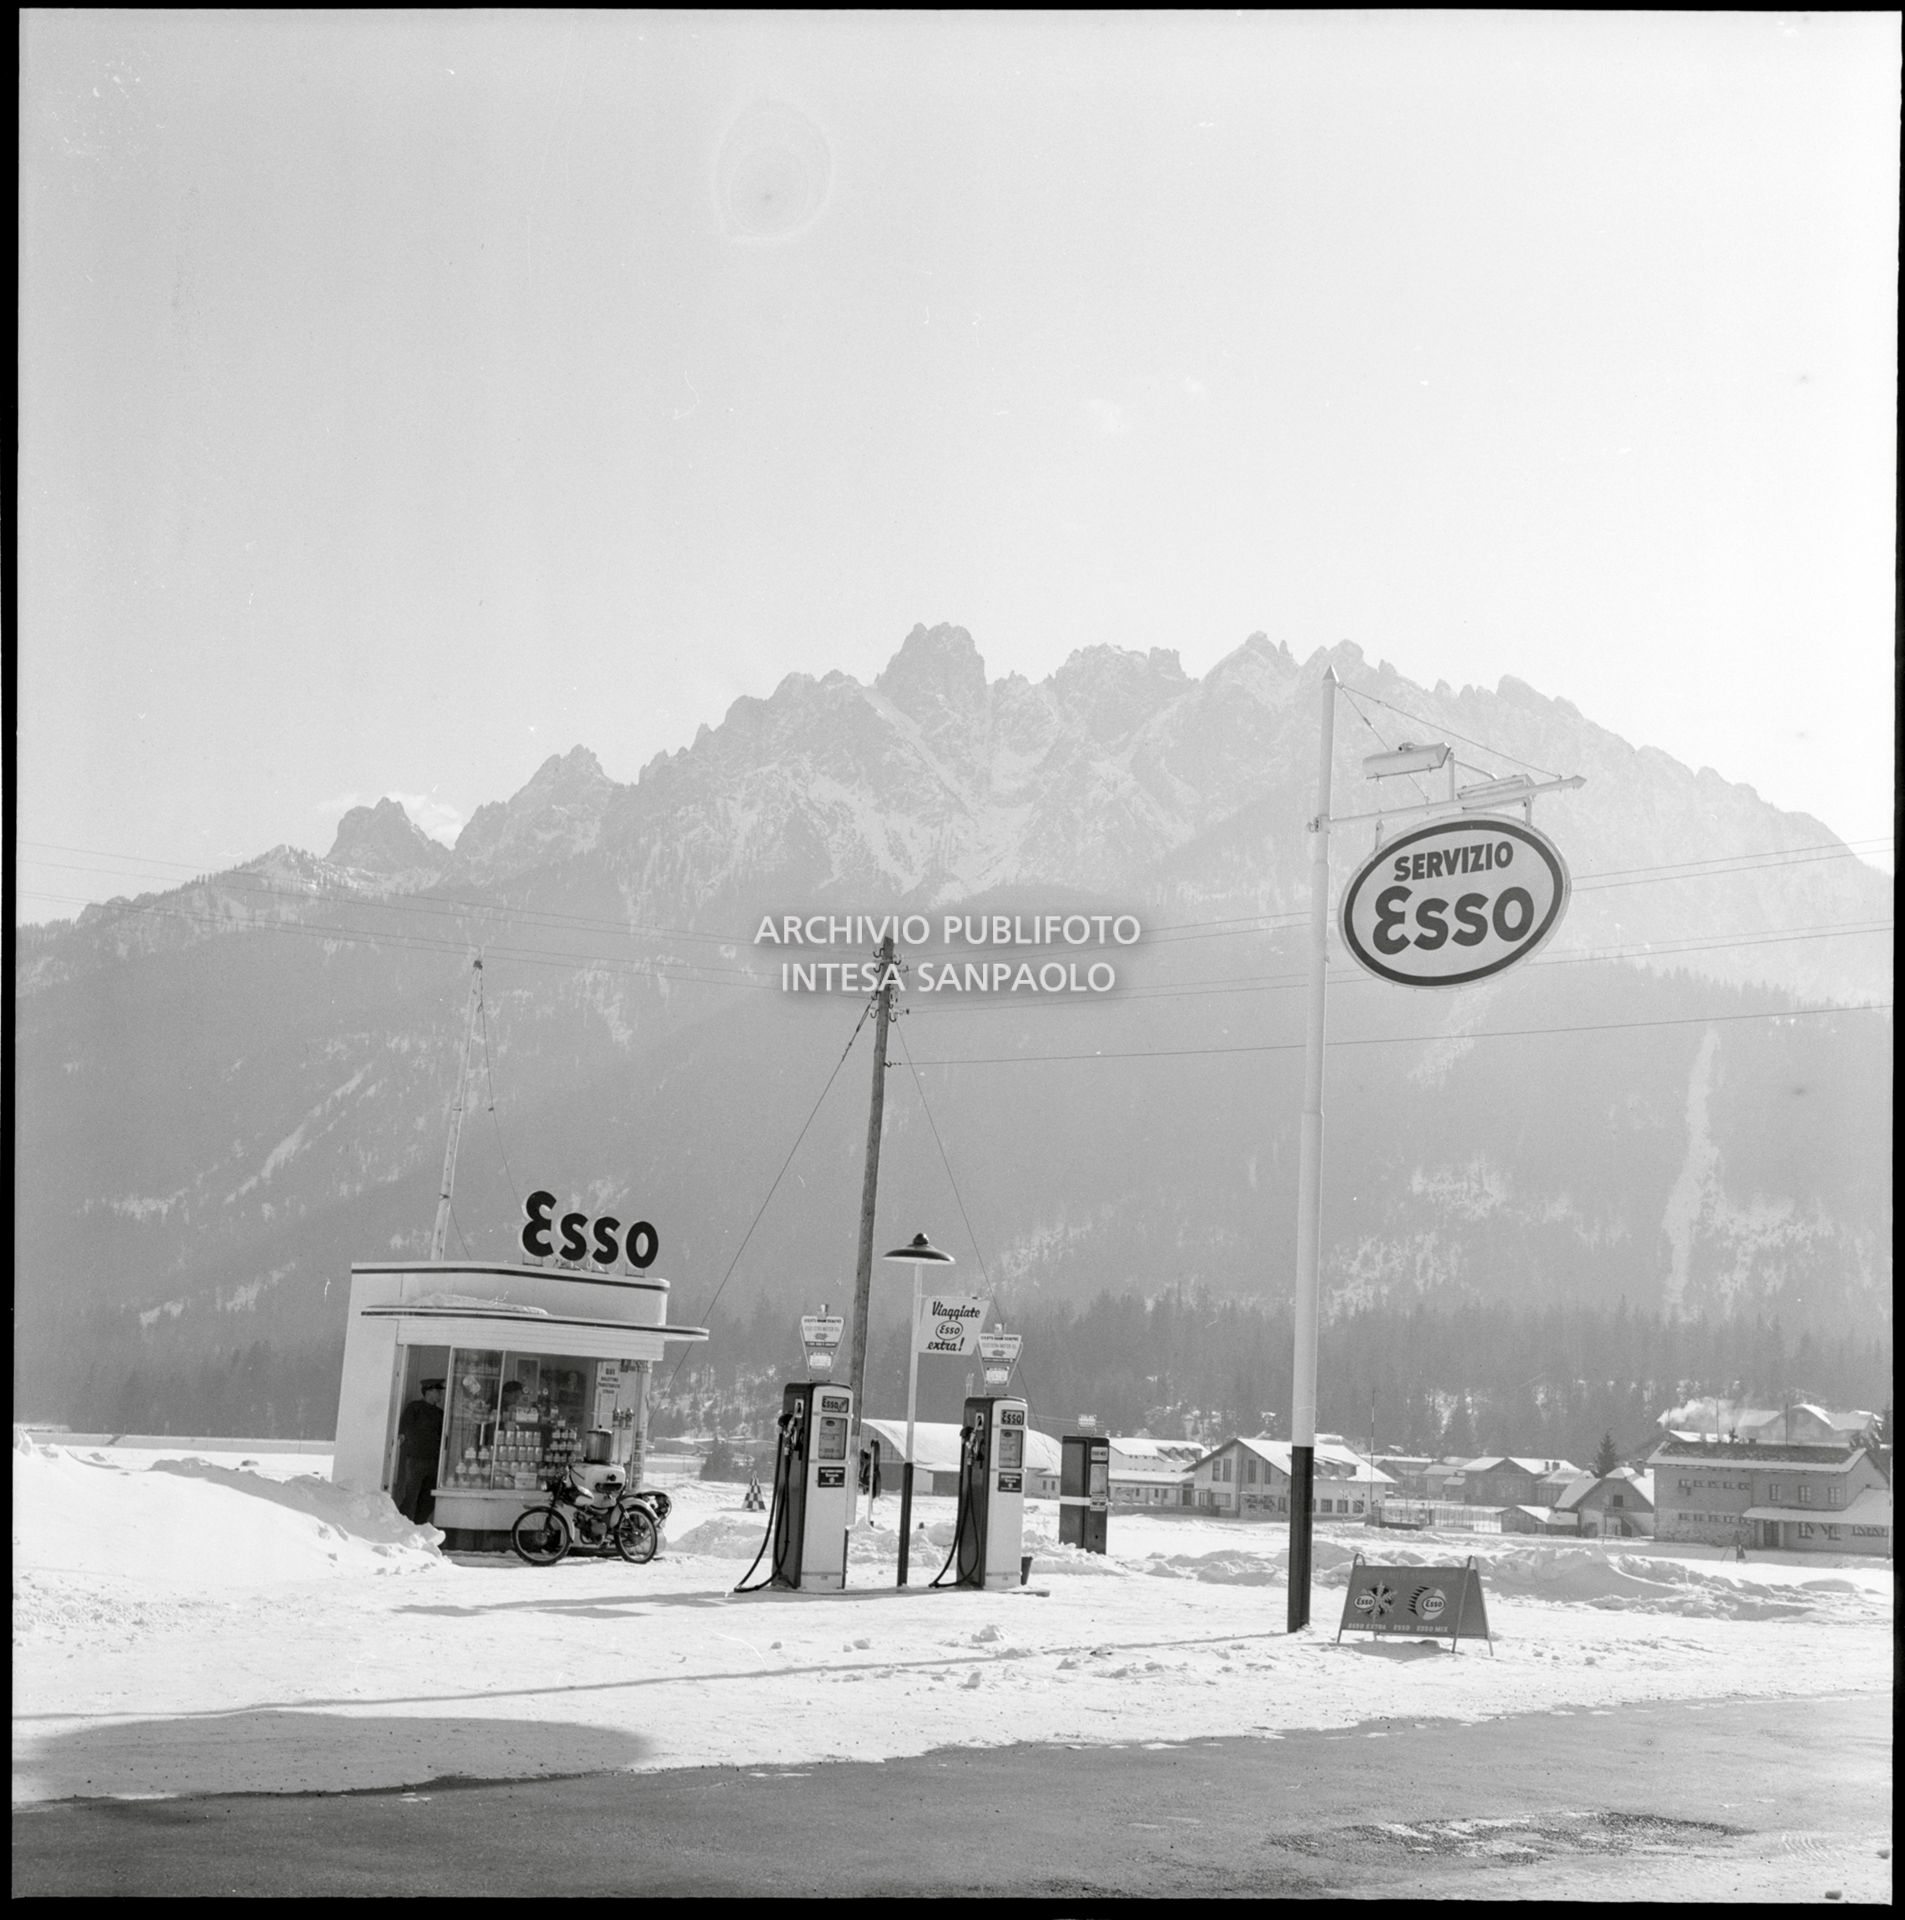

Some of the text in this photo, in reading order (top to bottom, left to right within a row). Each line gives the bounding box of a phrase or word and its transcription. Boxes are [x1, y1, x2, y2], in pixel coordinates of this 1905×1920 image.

[1393, 841, 1514, 882] SERVIZIO
[932, 1301, 981, 1320] Viaggiate
[927, 1337, 965, 1352] extra!
